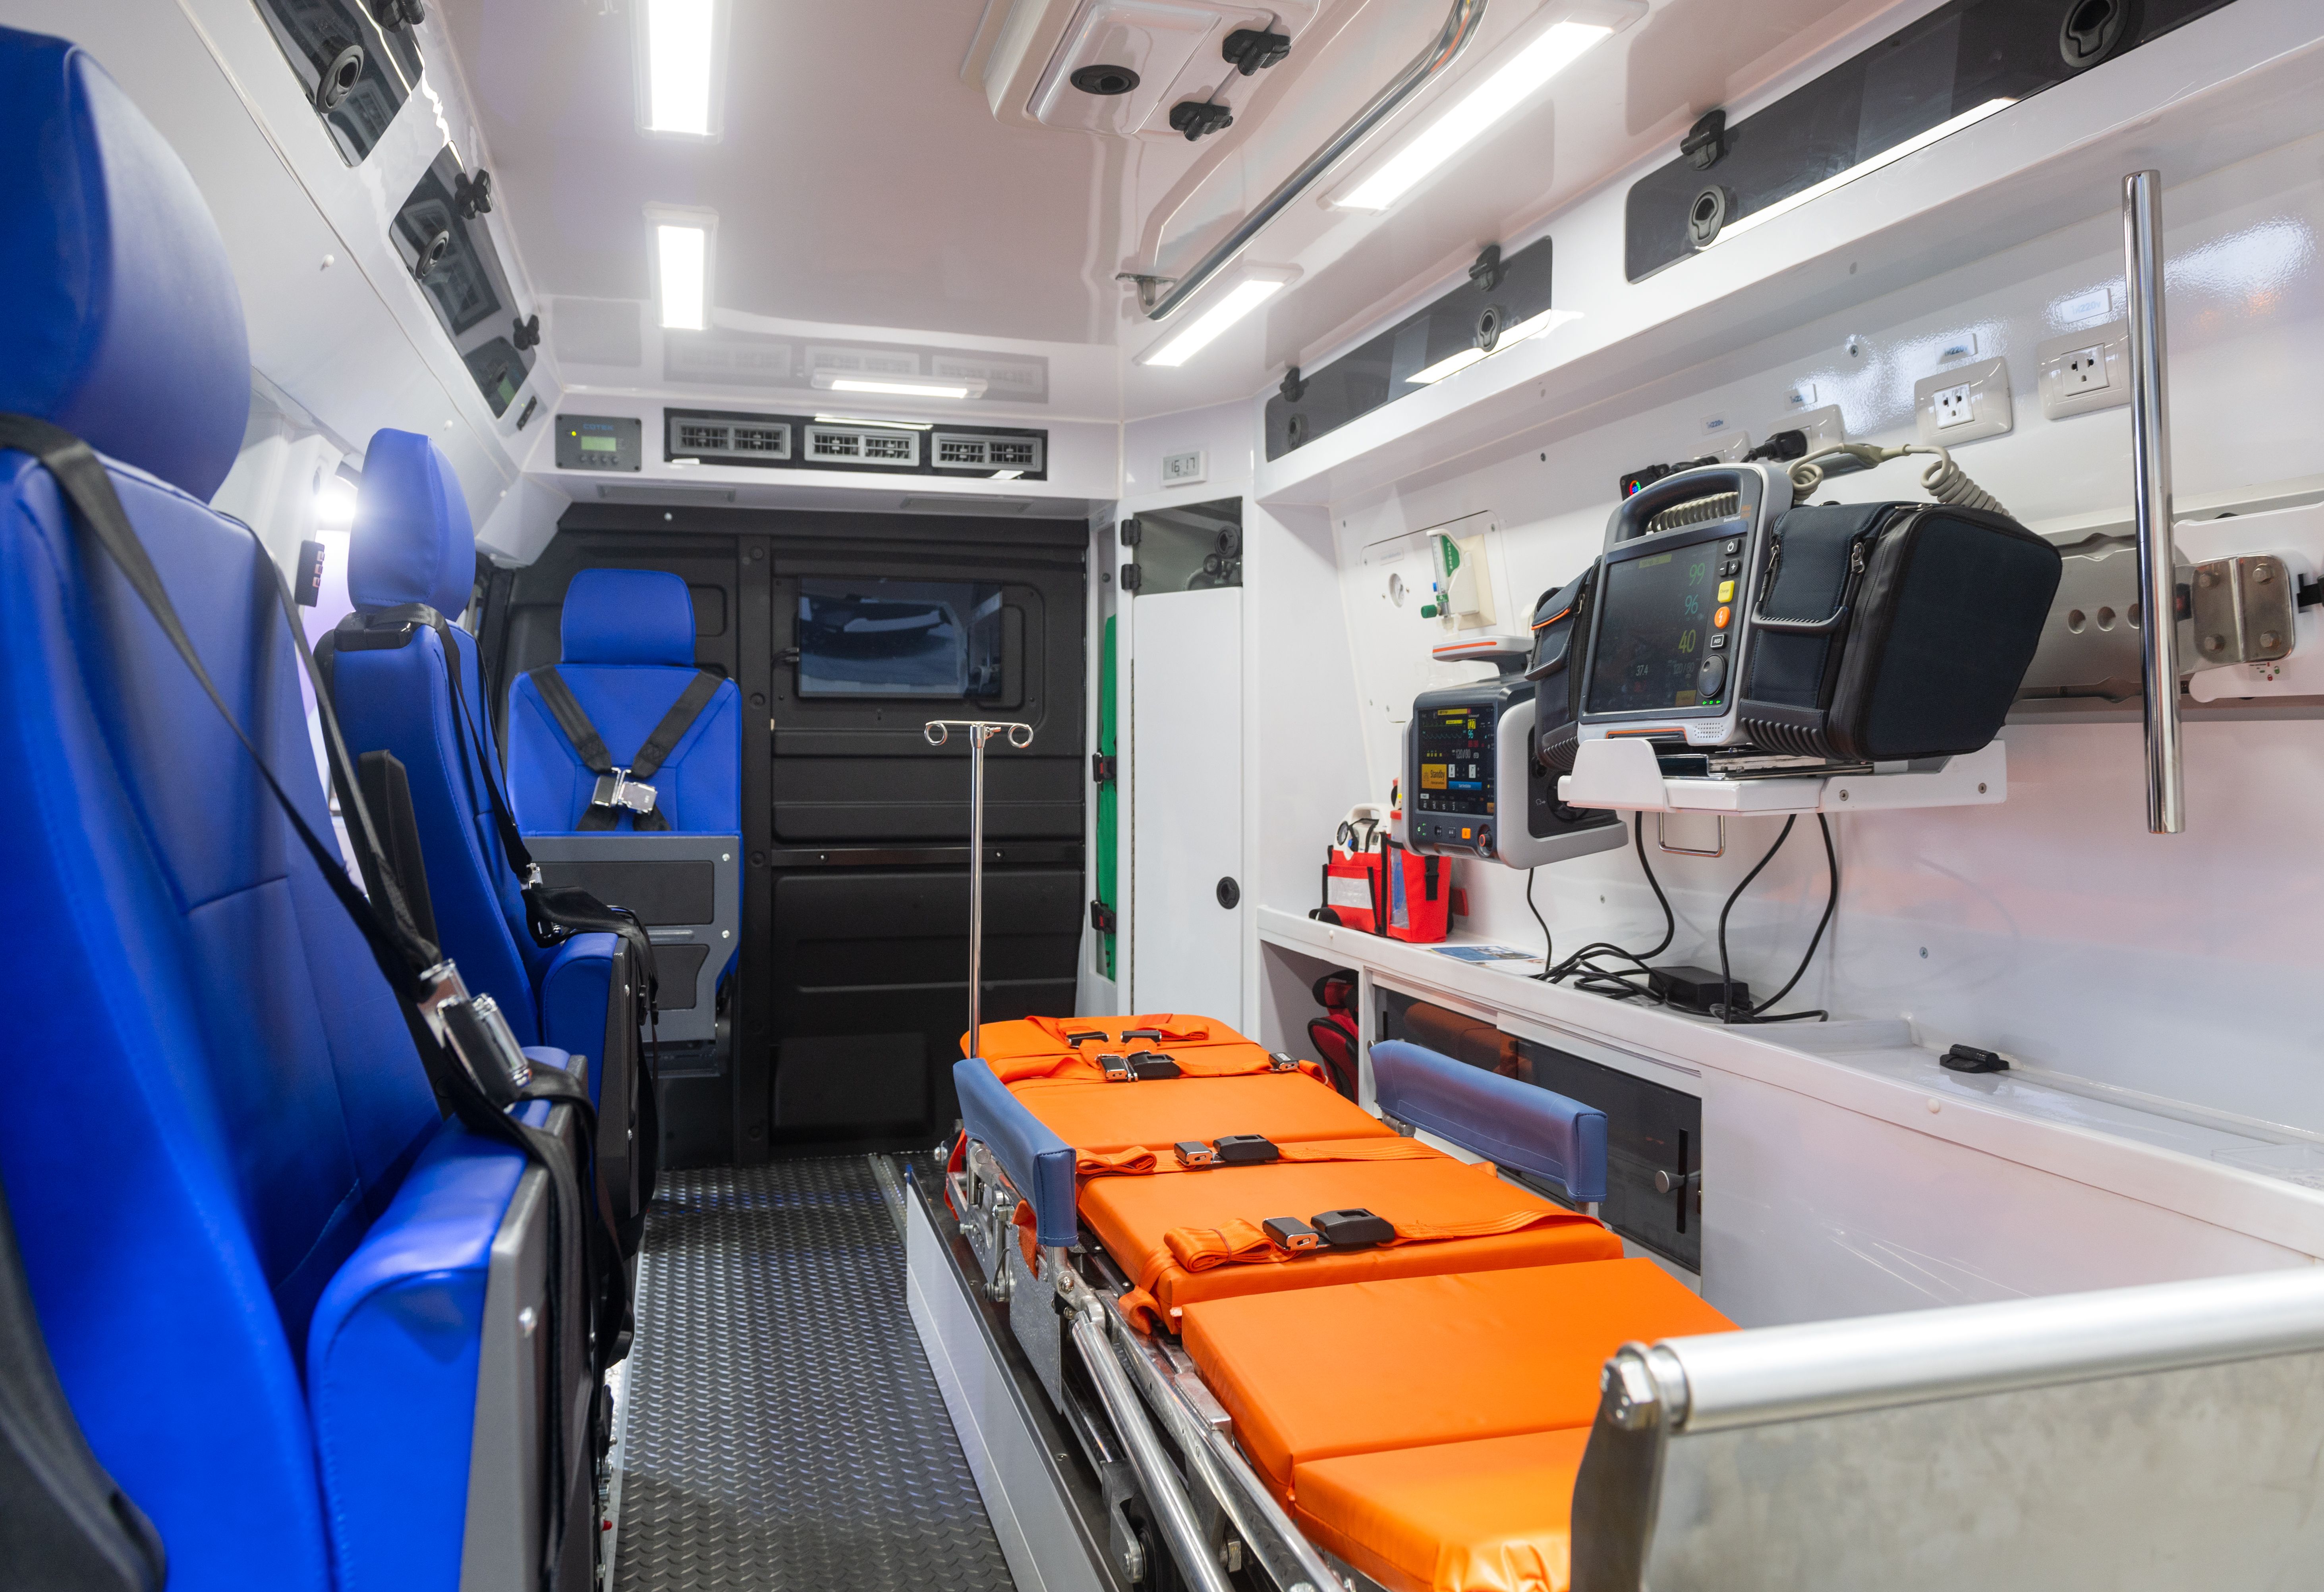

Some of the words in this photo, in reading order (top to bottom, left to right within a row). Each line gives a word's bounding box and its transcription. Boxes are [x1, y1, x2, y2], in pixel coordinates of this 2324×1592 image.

[1689, 562, 1706, 587] 99
[1685, 594, 1698, 616] 96
[1678, 629, 1696, 654] 40
[1636, 664, 1648, 676] 37.4
[1468, 729, 1474, 739] 96
[1430, 769, 1445, 780] Standby
